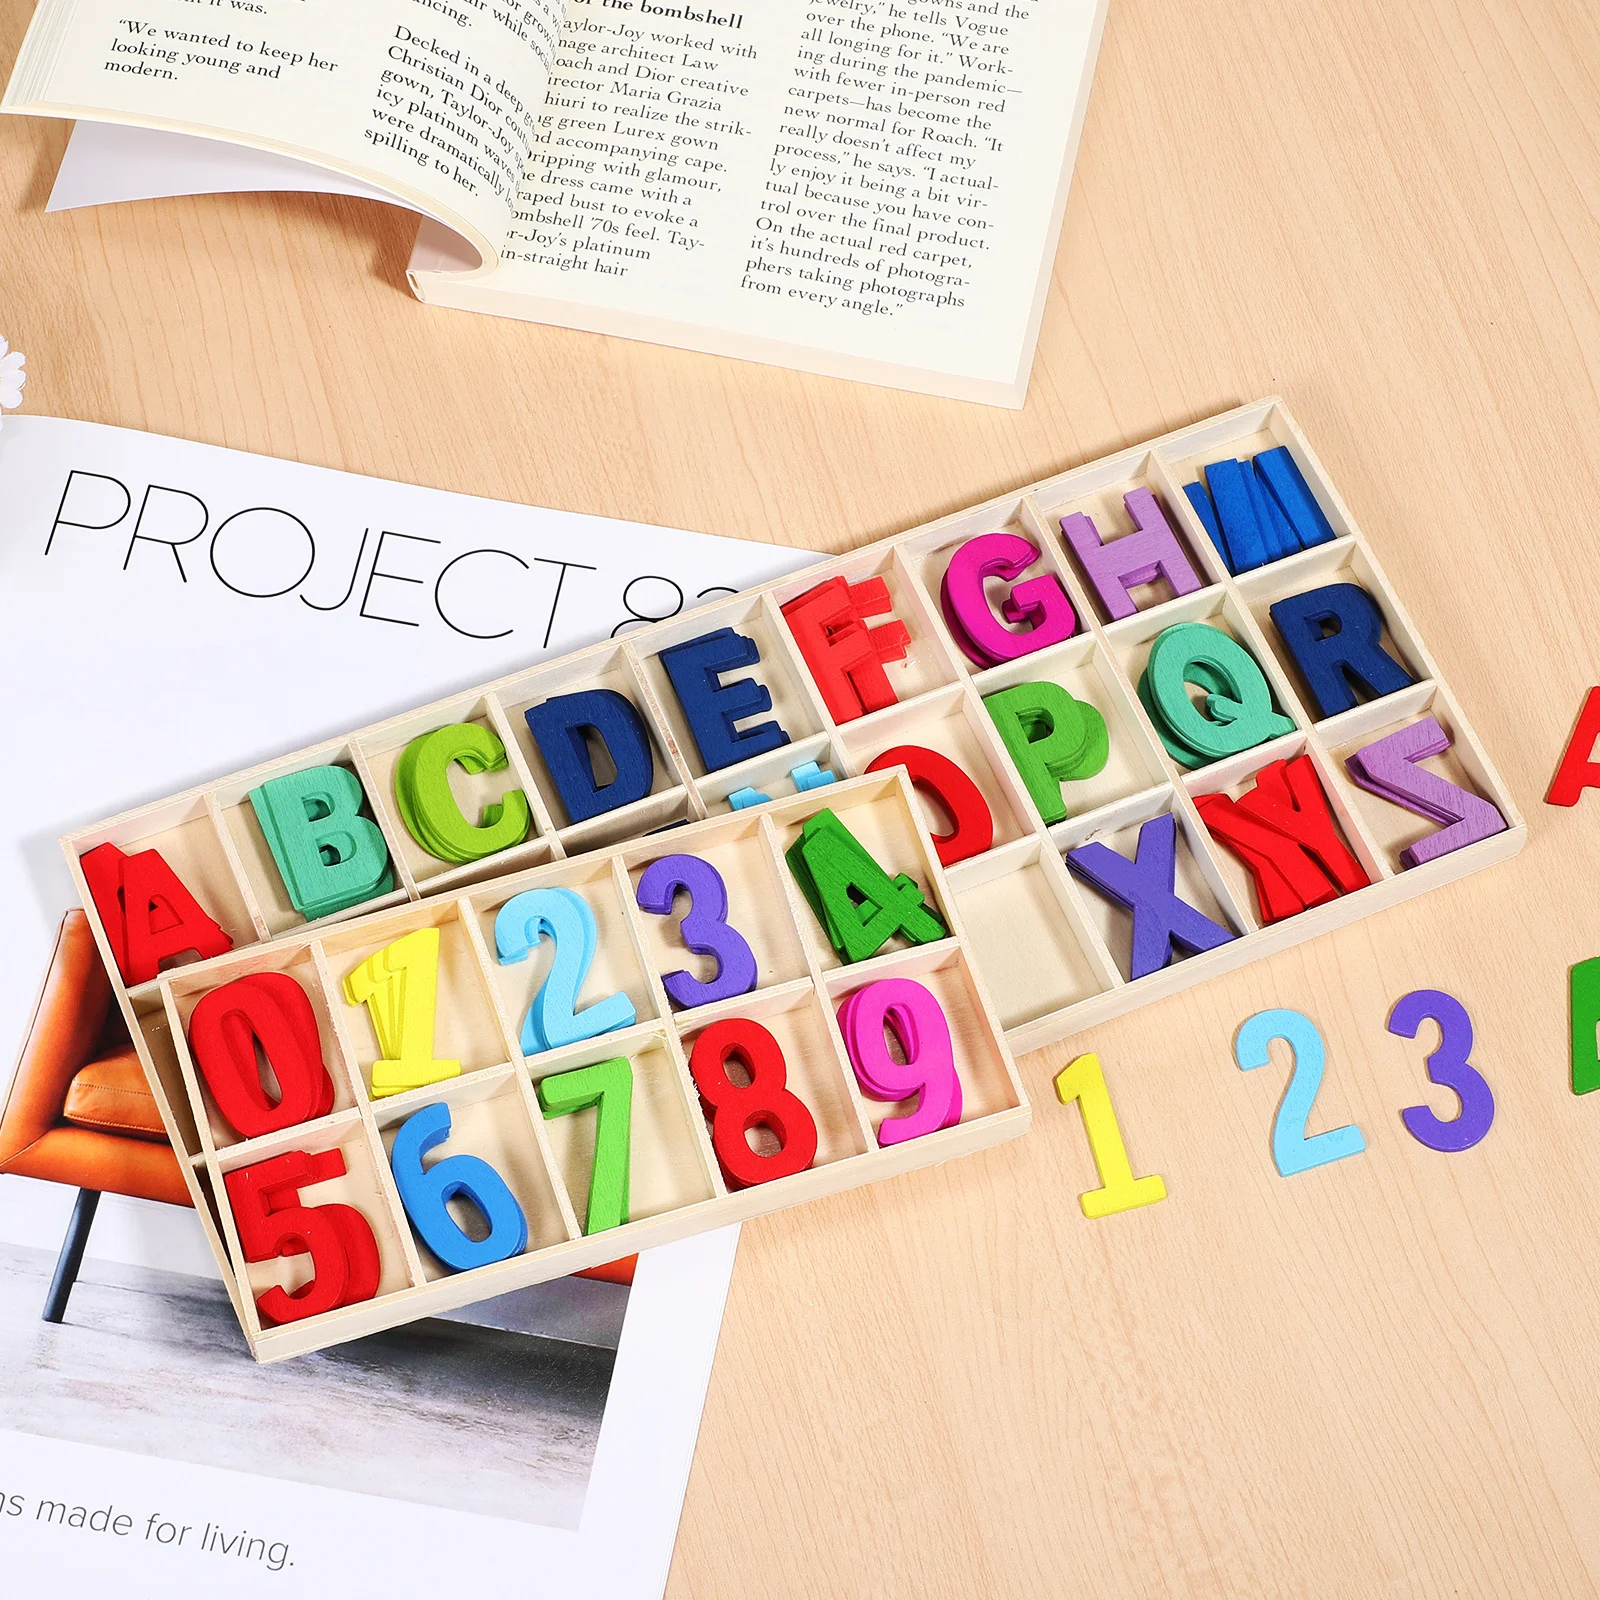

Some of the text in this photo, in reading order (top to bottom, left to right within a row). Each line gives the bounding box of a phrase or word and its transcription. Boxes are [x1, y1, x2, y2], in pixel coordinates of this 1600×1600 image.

[230, 0, 267, 14] was.
[492, 8, 528, 41] while
[640, 0, 743, 29] bombshell
[888, 3, 1008, 36] he tells Vogue
[967, 2, 1029, 20] and the
[164, 30, 231, 48] wanted
[236, 40, 254, 52] to
[259, 41, 303, 67] keep
[308, 52, 338, 72] her
[651, 33, 757, 59] worked with
[801, 27, 823, 42] all
[828, 31, 892, 58] longing
[897, 44, 922, 60] for
[959, 54, 1013, 74] Work-
[806, 13, 845, 26] over
[850, 16, 875, 32] the
[880, 23, 934, 43] phone.
[982, 44, 1009, 55] are
[103, 61, 178, 80] modern.
[110, 38, 281, 79] looking young and
[393, 24, 524, 114] Decked in a deep
[601, 44, 719, 71] architect Law
[797, 45, 825, 65] ing
[829, 51, 888, 77] during
[894, 63, 919, 79] the
[388, 45, 503, 115] Christian Dior
[597, 62, 749, 96] and Dior creative
[609, 81, 721, 112] Maria Grazia
[794, 66, 1006, 113] with fewer in-person red
[380, 69, 515, 155] gown, Taylor-Joy
[592, 101, 751, 136] to realize the strik-
[784, 106, 820, 119] new
[826, 114, 886, 132] normal
[891, 121, 916, 137] for
[921, 127, 977, 148] Roach.
[898, 102, 960, 125] become
[967, 114, 992, 130] the
[372, 108, 505, 197] were dramatically
[376, 84, 515, 184] icy platinum waves
[556, 137, 727, 173] accompanying cape.
[557, 118, 718, 151] green Lurex gown
[779, 124, 828, 144] really
[895, 143, 943, 162] affect
[949, 155, 976, 170] my
[364, 129, 478, 197] spilling to her.
[603, 161, 721, 192] with glamour,
[770, 158, 988, 208] ly enjoy it being a bit vir-
[853, 153, 872, 169] he
[877, 163, 915, 178] says.
[939, 174, 998, 190] actual-
[540, 170, 691, 206] dress came with a
[765, 181, 994, 229] tual because you have con-
[570, 193, 698, 228] bust to evoke a
[761, 200, 989, 250] trol over the final product.
[572, 236, 650, 260] platinum
[625, 223, 659, 241] feel.
[668, 230, 705, 251] Tay-
[756, 217, 972, 269] On the actual red carpet,
[594, 258, 628, 276] hair
[745, 256, 965, 308] phers taking photographs
[779, 240, 859, 268] hundreds
[865, 259, 885, 272] of
[887, 262, 970, 287] photogra-
[740, 274, 781, 295] from
[788, 289, 838, 308] every
[45, 470, 596, 648] PROJECT
[1138, 582, 1419, 769] Q R
[249, 486, 1208, 921] B C E G H
[637, 854, 758, 1009] 3
[689, 1017, 818, 1191] 8
[1053, 988, 1496, 1219] 1 2 3
[36, 1501, 132, 1535] made
[146, 1513, 192, 1545] for
[201, 1523, 293, 1571] living.
